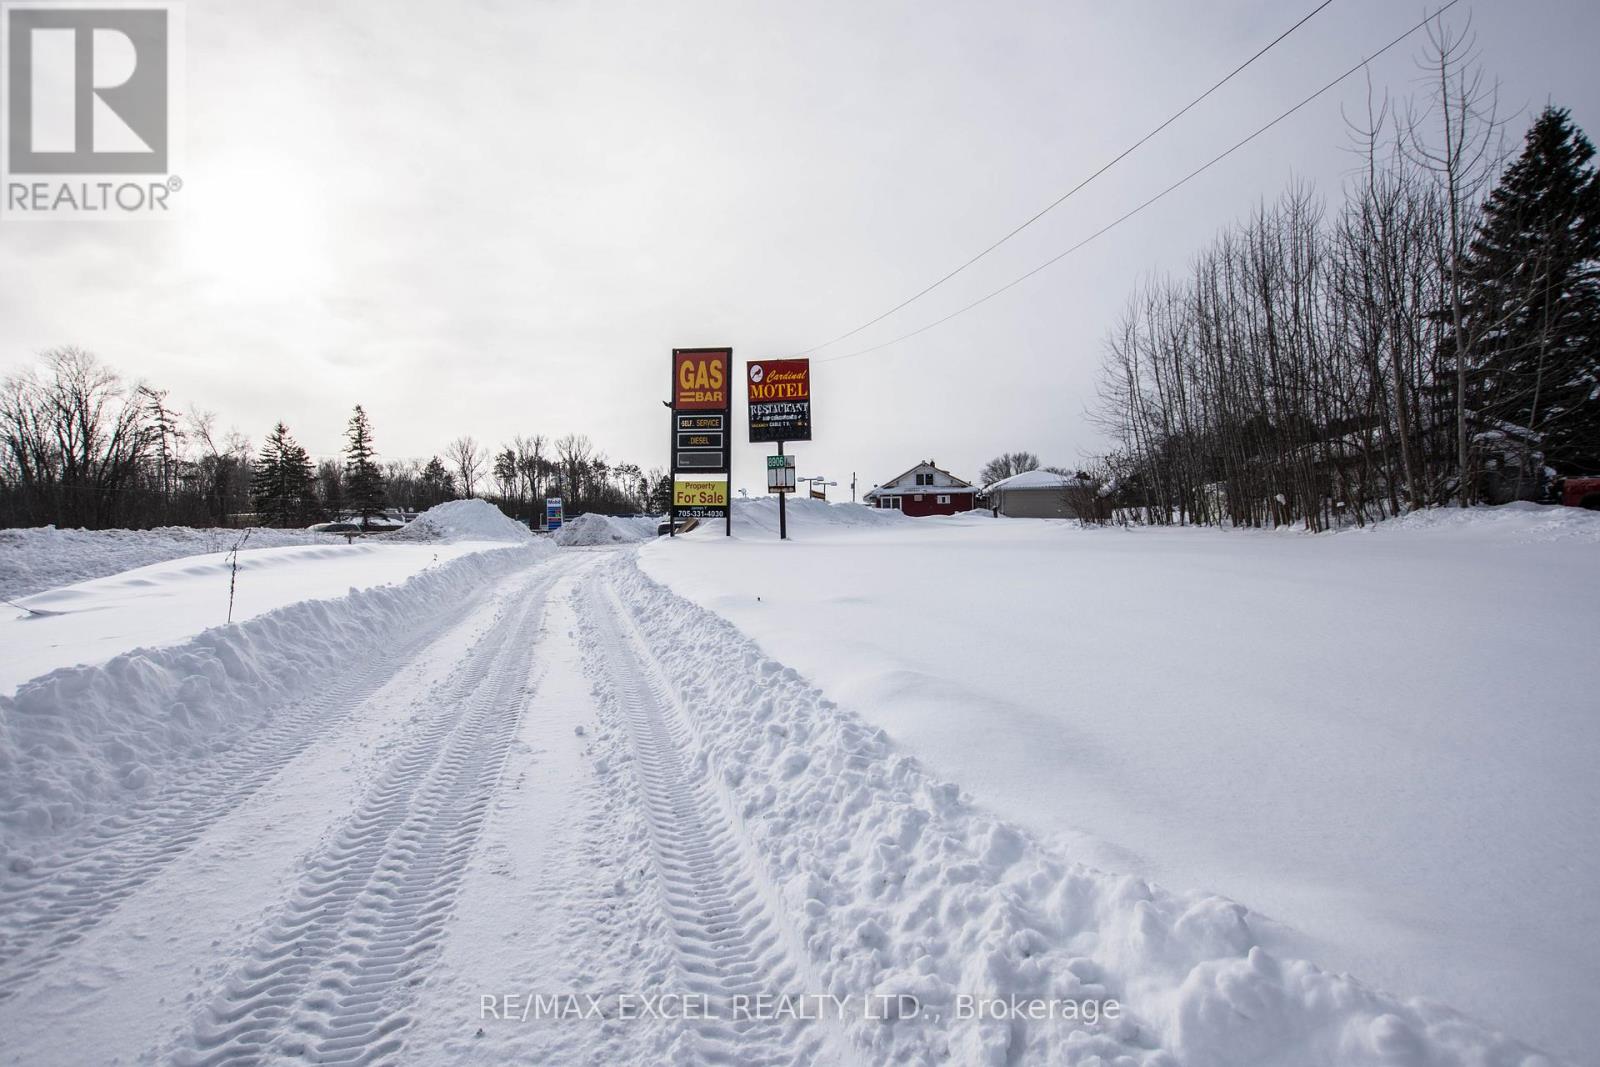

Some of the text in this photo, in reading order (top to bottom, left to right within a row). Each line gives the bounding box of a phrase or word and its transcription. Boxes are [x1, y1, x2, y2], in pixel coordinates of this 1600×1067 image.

[680, 359, 723, 390] GAS
[766, 369, 806, 383] Cardinal
[695, 392, 723, 402] BAR
[750, 383, 808, 399] MOTEL
[750, 402, 809, 415] RESTAURANT
[690, 436, 709, 445] DIESEL
[768, 456, 784, 467] 8906
[685, 482, 716, 491] Property
[677, 491, 724, 504] For Sale
